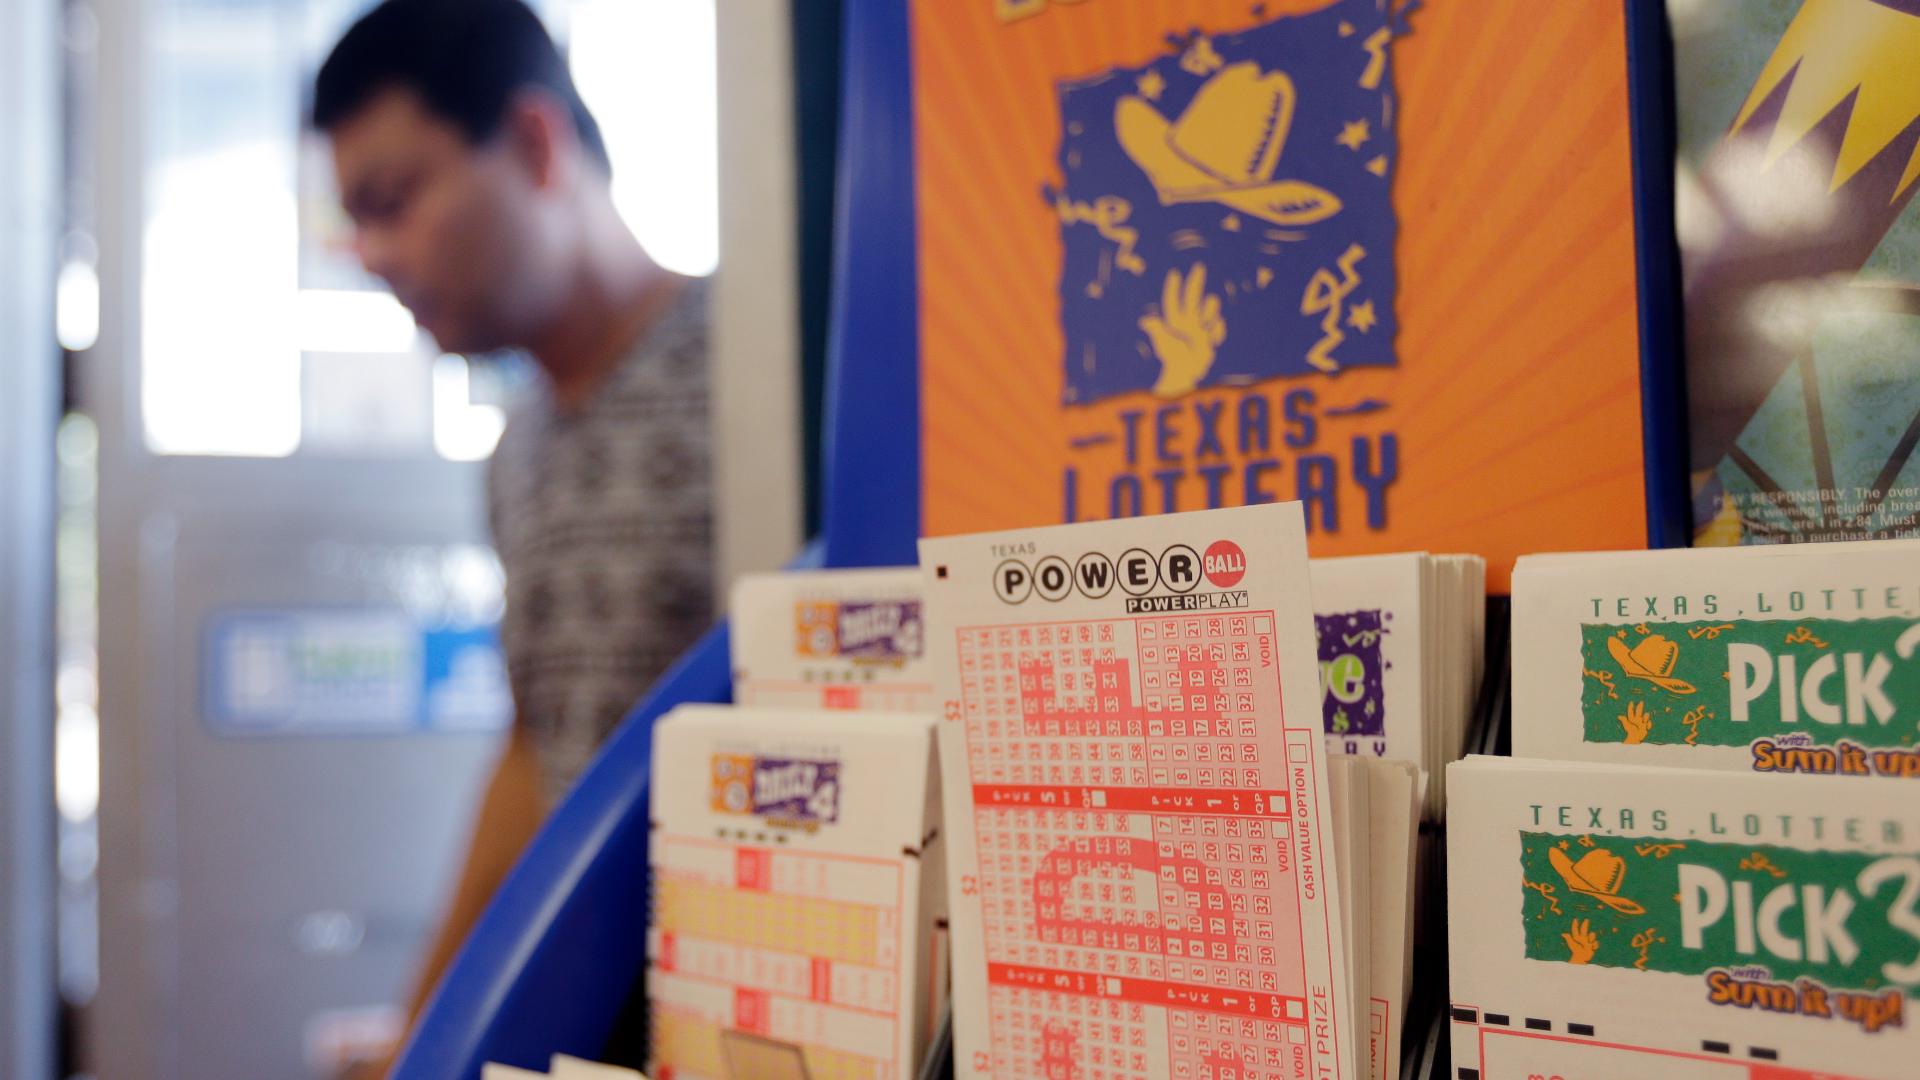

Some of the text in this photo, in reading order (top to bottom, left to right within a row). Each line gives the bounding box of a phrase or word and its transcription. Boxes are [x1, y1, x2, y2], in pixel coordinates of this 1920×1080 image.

[1119, 389, 1318, 466] TEXAS
[1824, 501, 1885, 516] including
[1856, 488, 1880, 498] The
[1880, 513, 1916, 526] Must
[990, 542, 1036, 558] TEXAS
[1592, 595, 1718, 617] TEXAS
[1260, 636, 1271, 668] VOID
[1727, 642, 1896, 726] PICK
[1752, 740, 1836, 774] Sum
[1840, 741, 1870, 776] it
[1255, 793, 1264, 814] QP
[1529, 804, 1667, 831] TEXAS
[1295, 768, 1315, 900] CASH VALUE OPTION
[1277, 841, 1289, 873] VOID
[1677, 864, 1860, 967] PICK
[1271, 996, 1281, 1017] QP
[1707, 970, 1796, 1013] Sum
[1801, 980, 1832, 1018] it
[1313, 985, 1330, 1055] PRIZE
[1294, 1046, 1304, 1079] VOID
